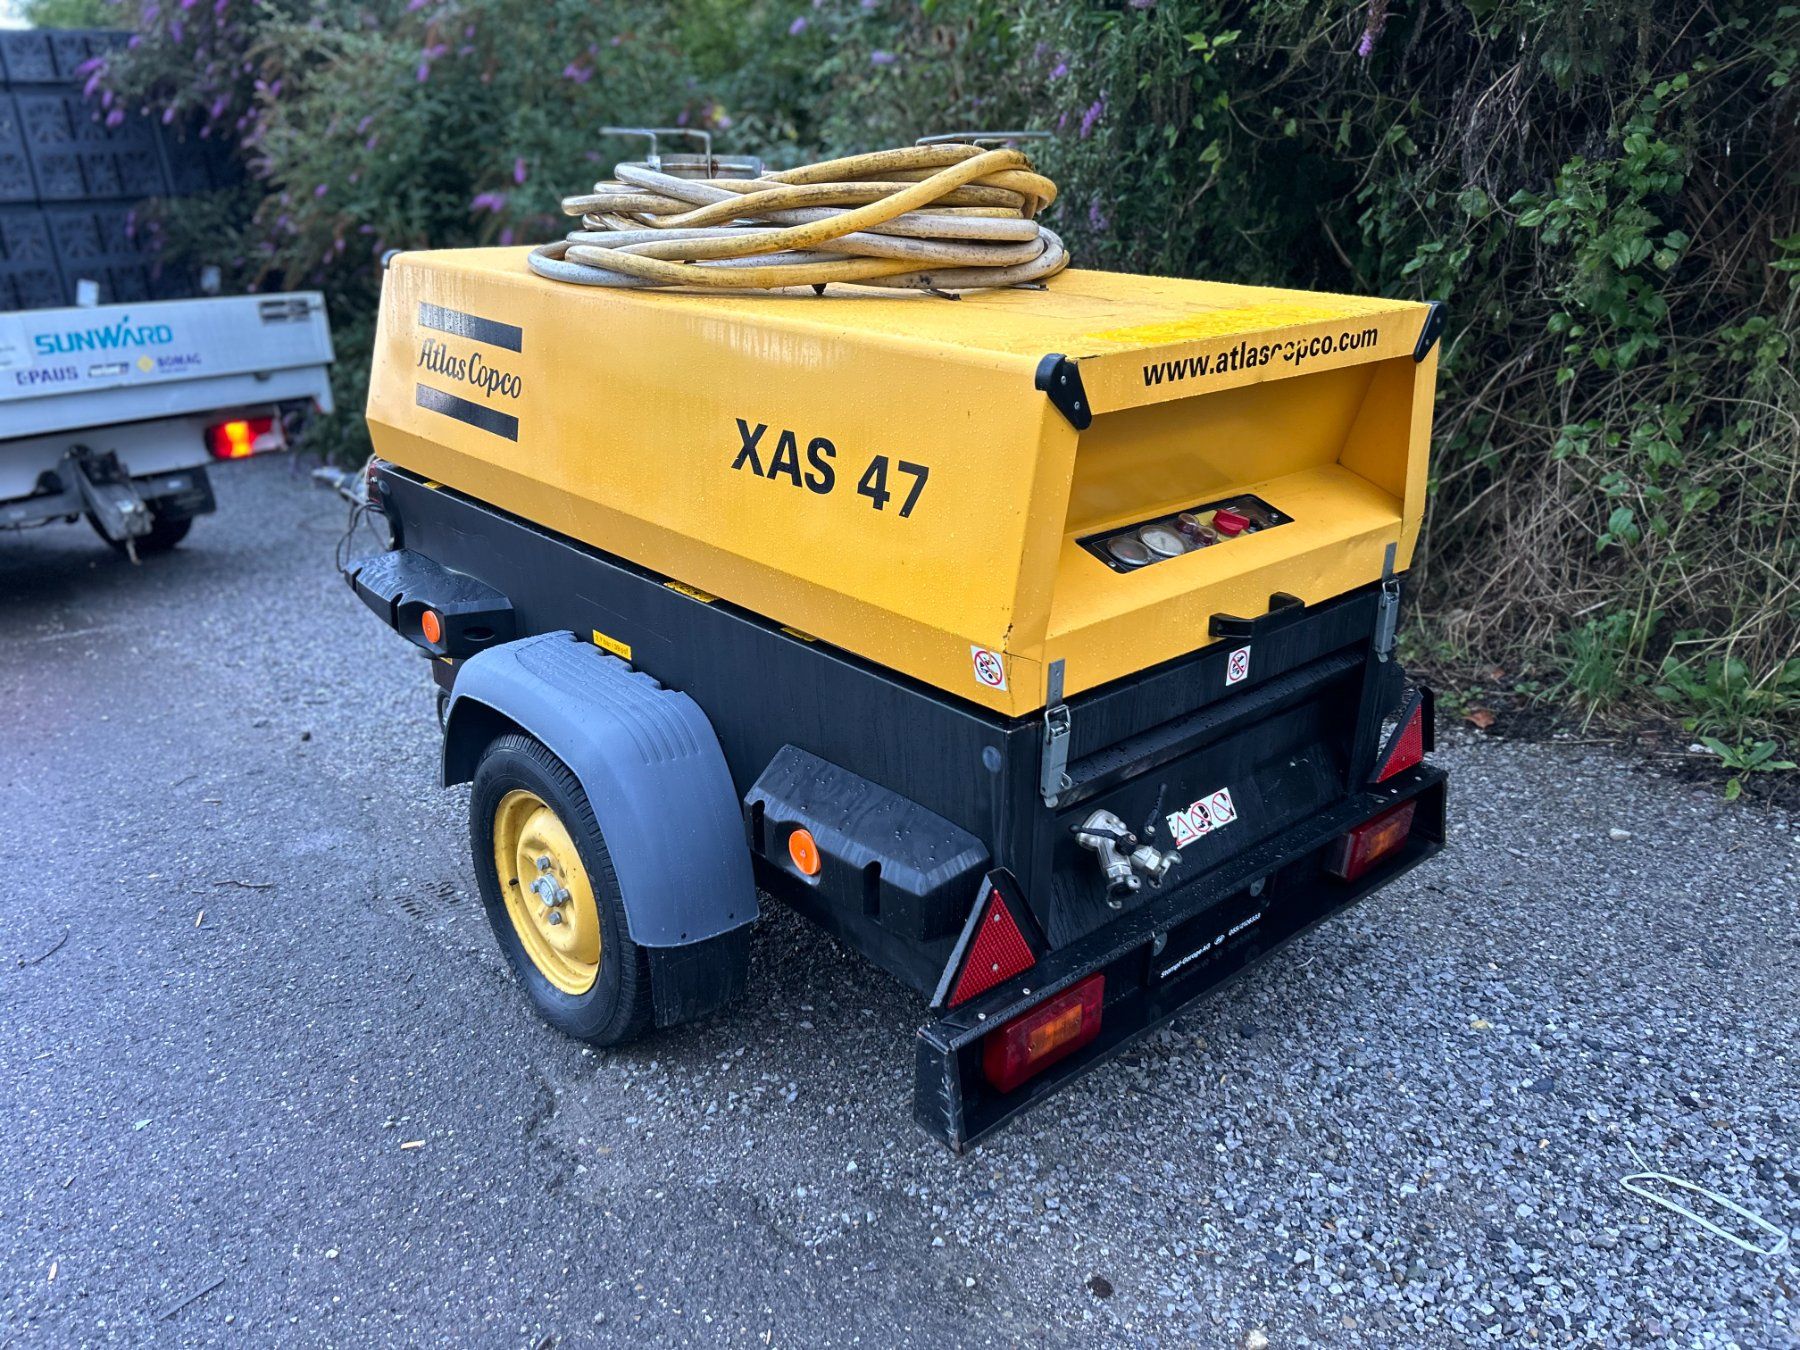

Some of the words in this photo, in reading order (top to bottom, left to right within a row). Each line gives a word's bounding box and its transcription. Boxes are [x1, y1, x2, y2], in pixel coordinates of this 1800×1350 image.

[34, 315, 174, 355] SUNWARD
[416, 337, 467, 381] Atlas
[468, 352, 522, 399] Copco
[731, 417, 837, 495] XAS
[857, 454, 930, 519] 47
